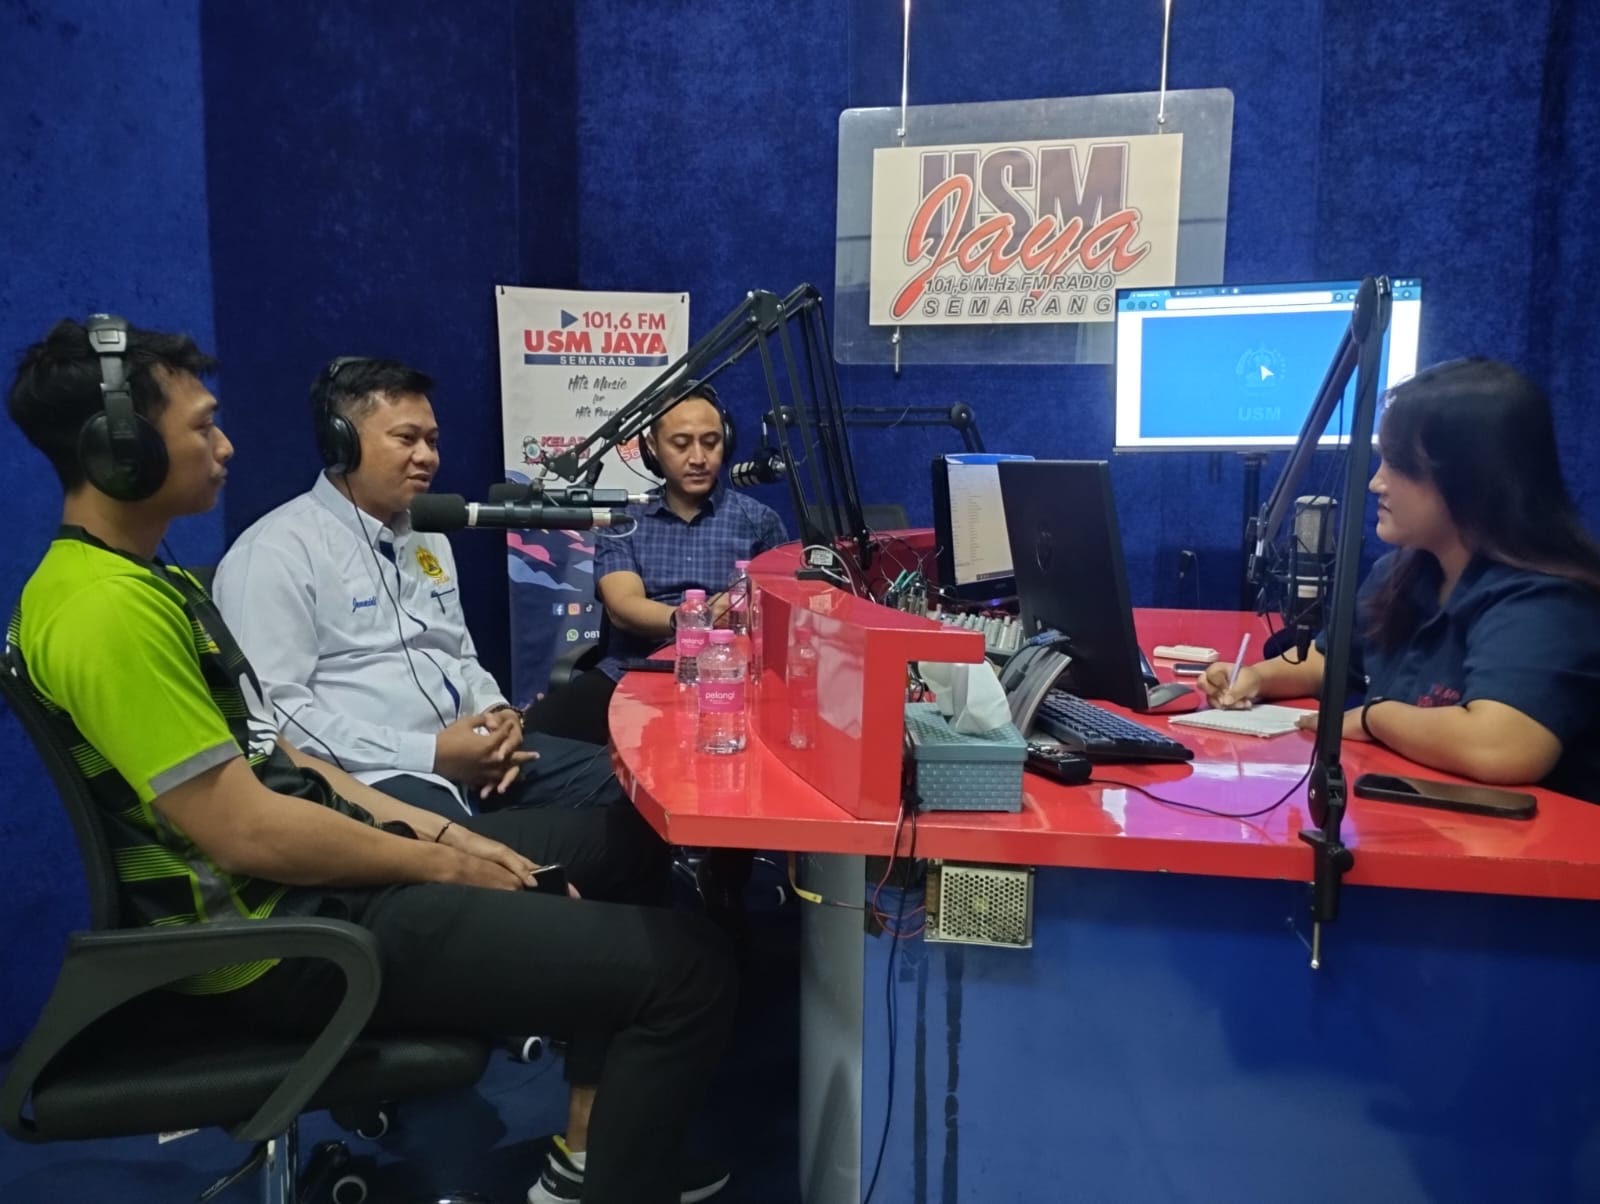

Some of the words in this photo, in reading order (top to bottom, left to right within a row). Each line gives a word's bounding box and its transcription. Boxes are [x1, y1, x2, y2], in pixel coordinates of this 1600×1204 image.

[920, 143, 1129, 256] USM
[890, 173, 1151, 319] Jaya
[925, 276, 969, 295] 101,6
[1021, 274, 1050, 292] FM
[1052, 273, 1115, 291] RADIO
[923, 295, 1114, 316] SEMARANG
[582, 311, 632, 331] 101,6
[638, 313, 666, 330] FM
[524, 329, 592, 353] USM
[601, 332, 667, 354] JAYA
[560, 355, 636, 366] SEMARANG
[593, 375, 627, 391] Music
[1238, 407, 1280, 421] USM
[705, 691, 735, 700] pelangi
